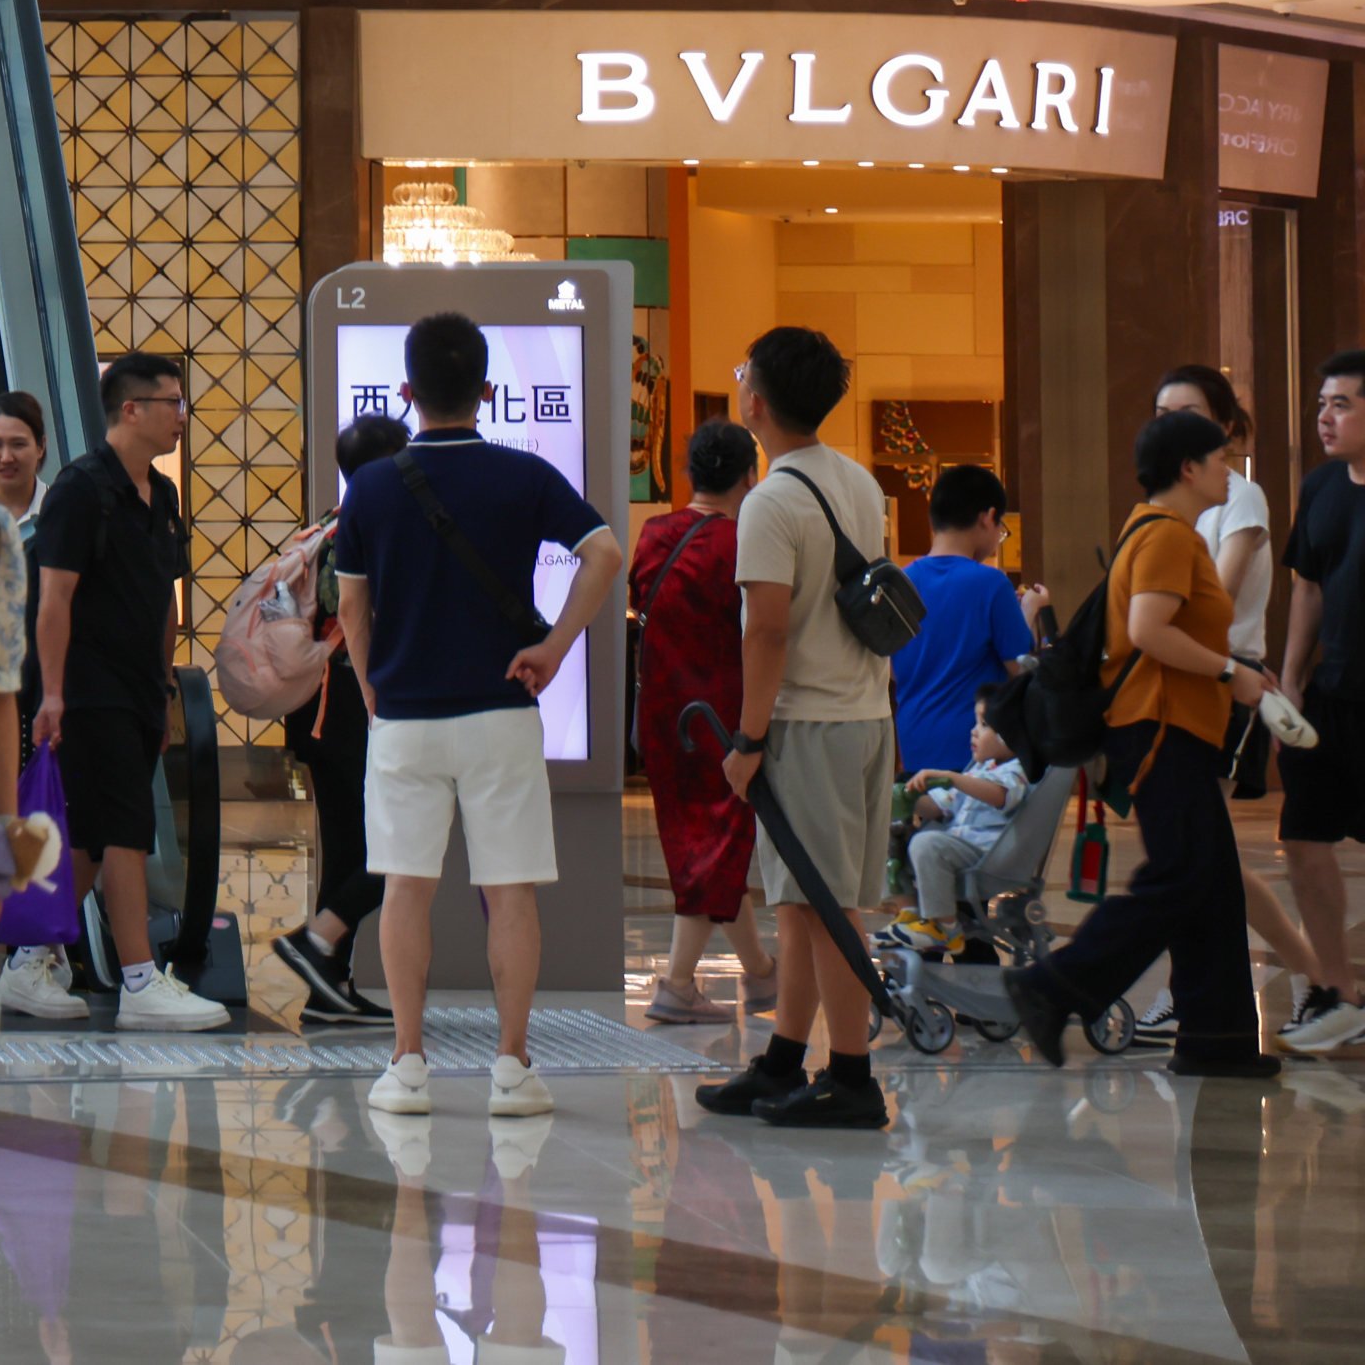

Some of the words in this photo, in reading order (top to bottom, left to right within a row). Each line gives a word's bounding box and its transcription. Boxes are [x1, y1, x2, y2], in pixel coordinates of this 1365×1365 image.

[576, 52, 1114, 134] BVLGARI
[336, 287, 366, 309] L2
[548, 298, 585, 310] METAL
[350, 385, 572, 424] 西化區
